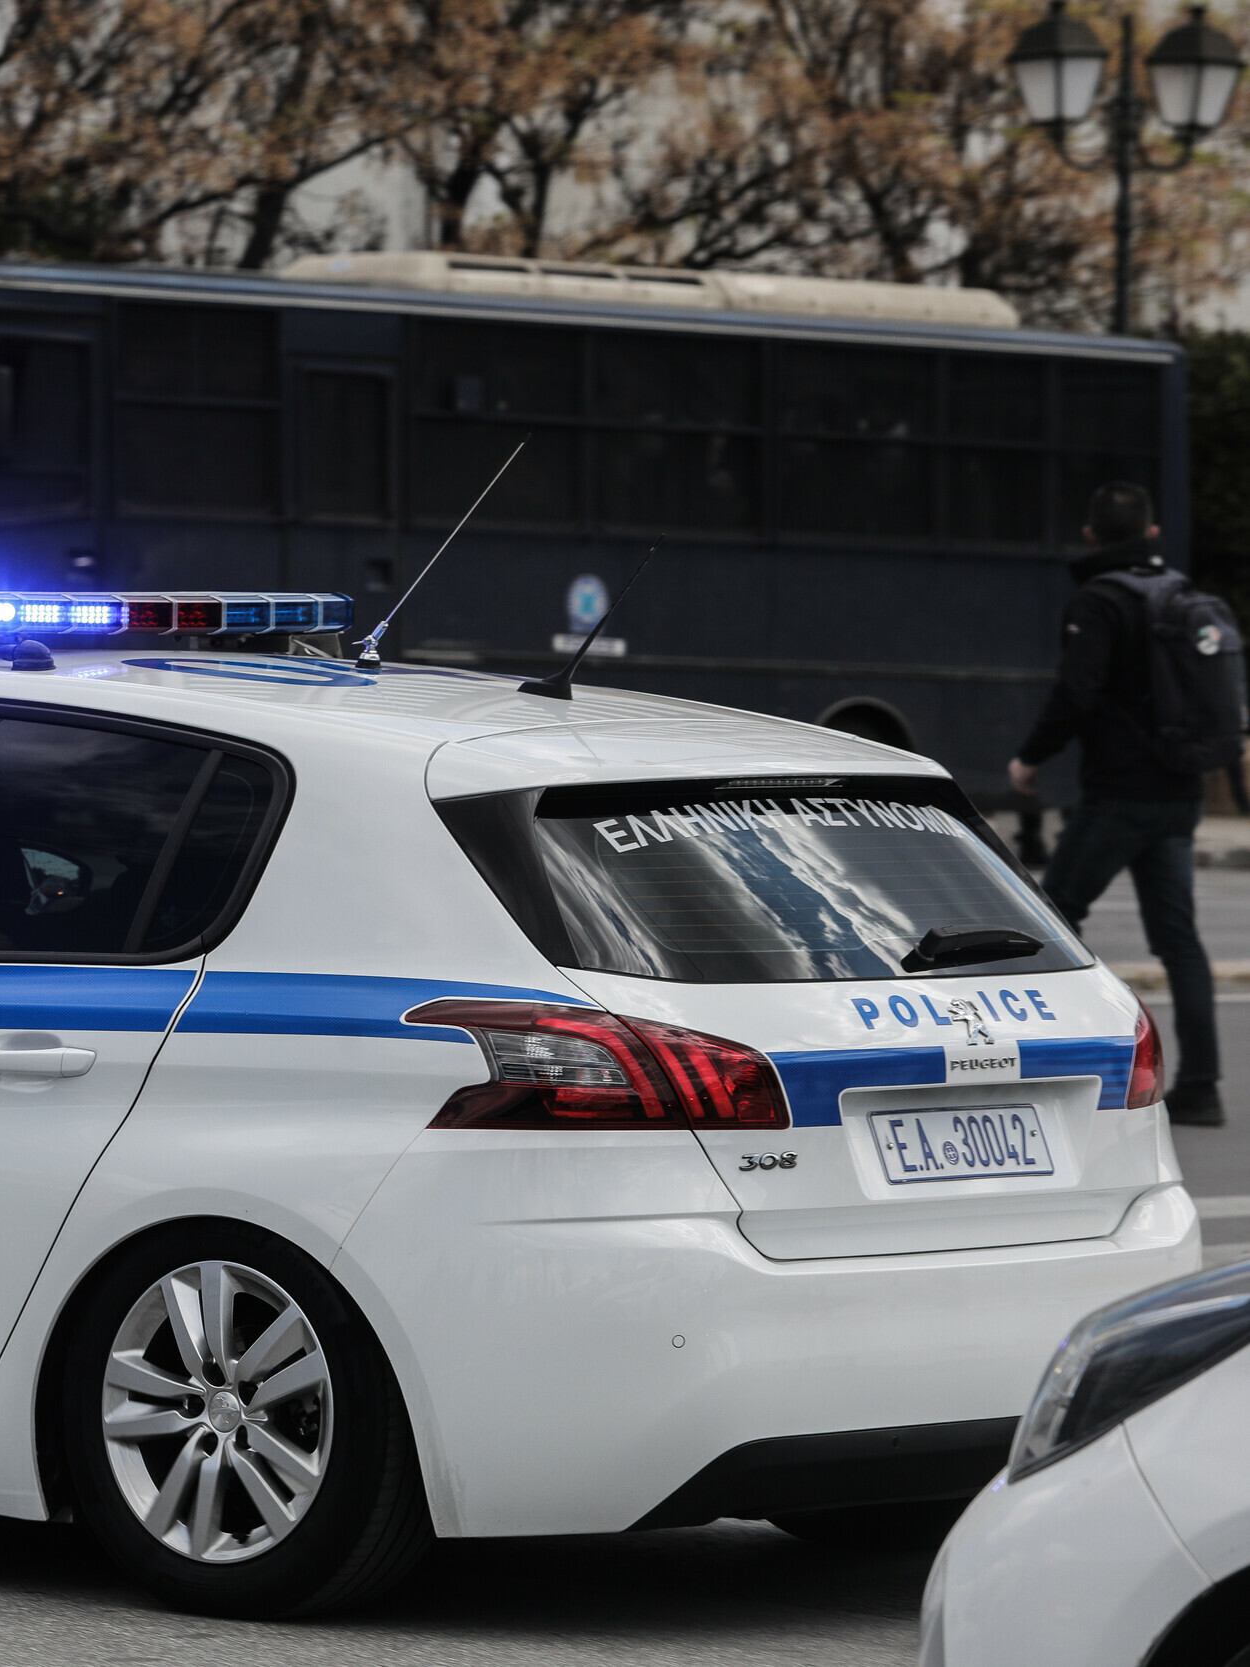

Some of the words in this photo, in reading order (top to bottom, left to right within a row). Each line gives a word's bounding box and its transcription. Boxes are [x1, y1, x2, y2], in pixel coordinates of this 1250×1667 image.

[592, 799, 797, 853] ΕΛΛΗΝΙΚΗ
[850, 989, 1057, 1030] POLICE
[950, 1057, 1017, 1071] PEUGEOT
[953, 1113, 1036, 1168] 30042
[739, 1151, 798, 1172] 308
